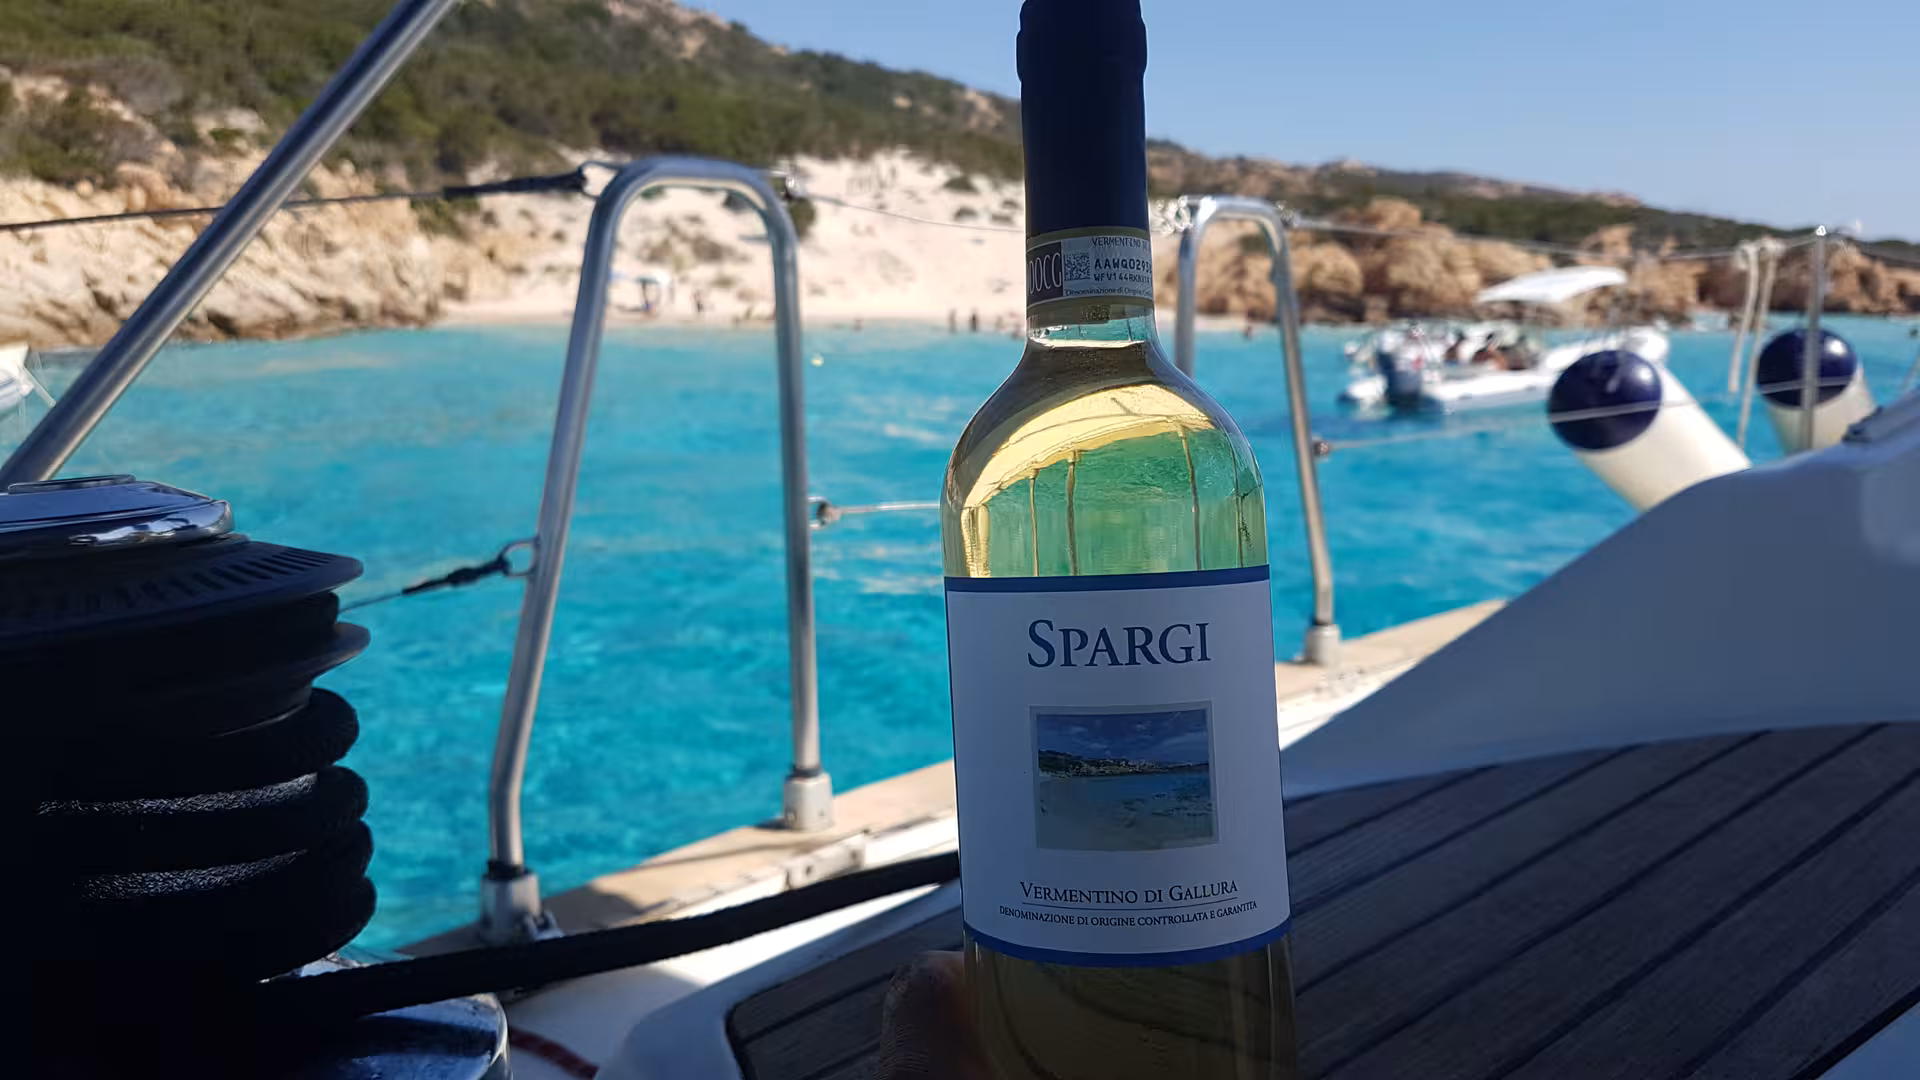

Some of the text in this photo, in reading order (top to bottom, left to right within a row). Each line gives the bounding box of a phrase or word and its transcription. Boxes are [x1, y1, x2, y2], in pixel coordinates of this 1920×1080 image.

[1029, 252, 1062, 294] DOCG
[1027, 619, 1211, 668] SPARGI
[1019, 879, 1239, 904] VERMENTINO DI GALLURA
[999, 900, 1257, 927] DENOMINAZIONE DI ORIGINE CONTROLLATA E GARANTITA
